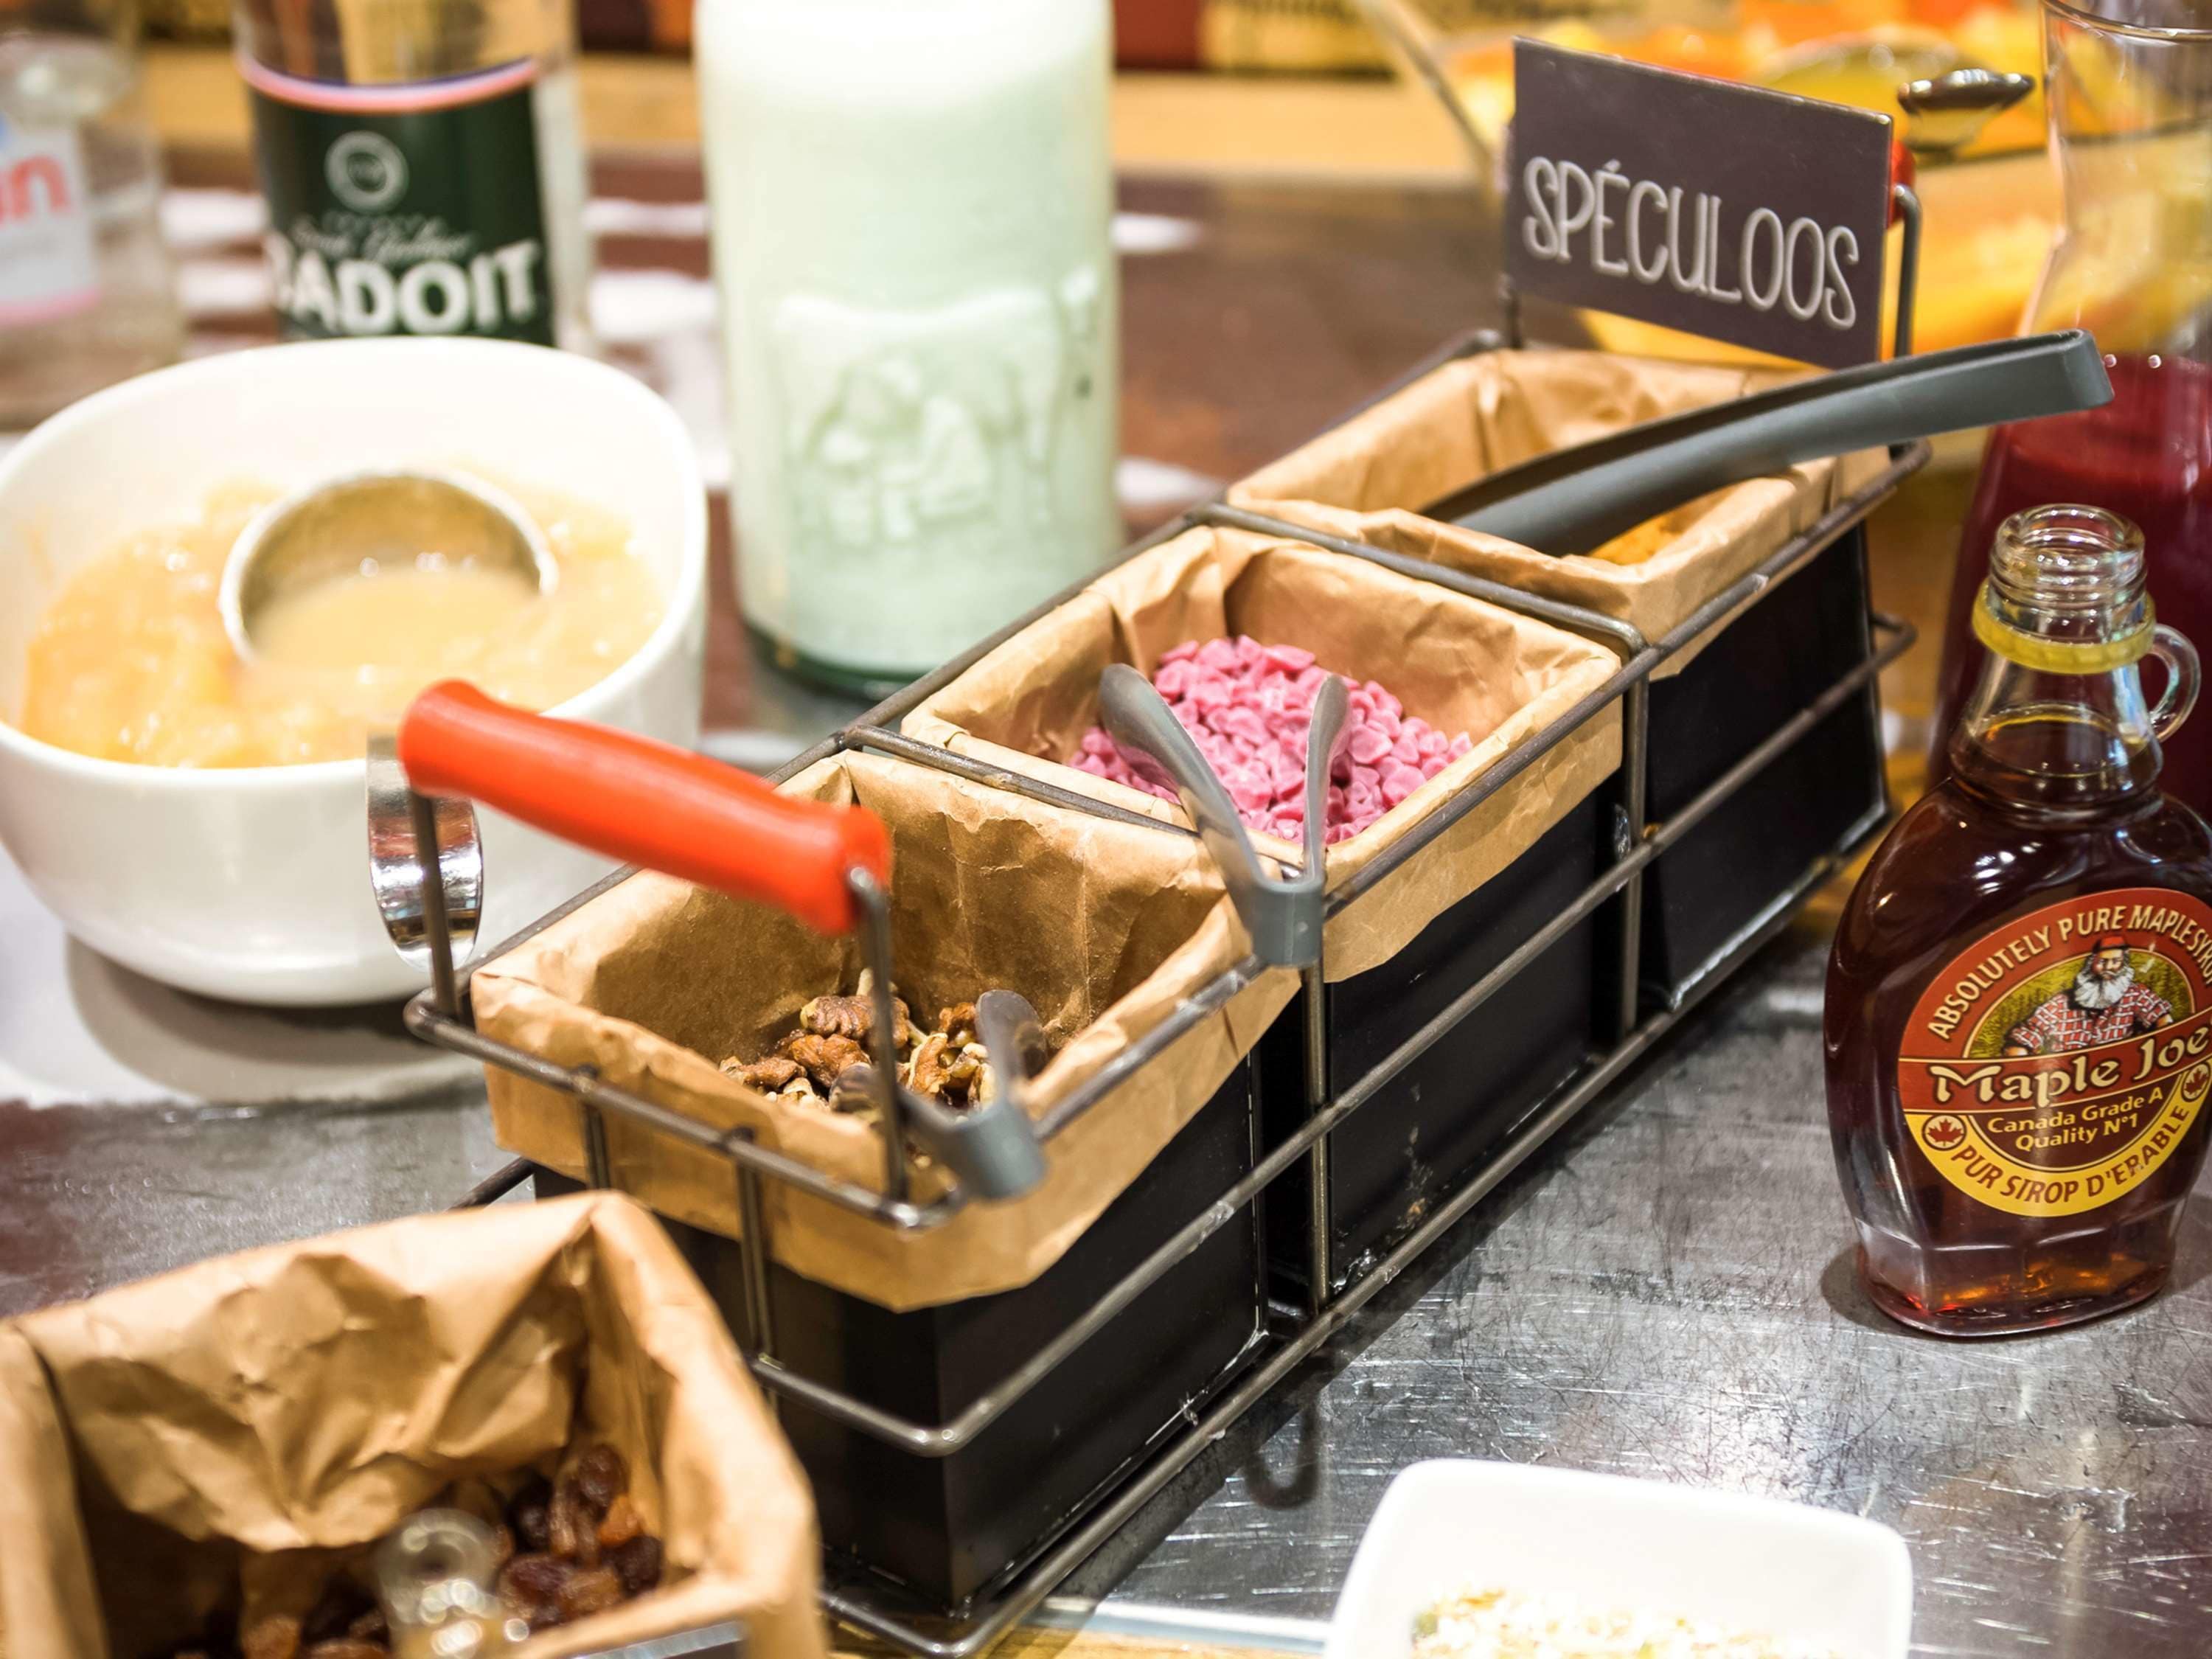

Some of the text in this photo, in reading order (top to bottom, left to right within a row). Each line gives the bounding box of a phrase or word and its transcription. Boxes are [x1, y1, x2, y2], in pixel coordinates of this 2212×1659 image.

[1522, 156, 1860, 330] SPÉCULOOS
[1927, 926, 2051, 1040] ABSOLUTELY
[2057, 905, 2126, 942] PURE
[2127, 904, 2197, 945] MAPLE
[1929, 1026, 2211, 1107] Maple Joe
[1987, 1087, 2164, 1134] Canada Grade A
[1950, 1105, 2190, 1205] PUR SIROP D'ERABLE
[2015, 1127, 2098, 1152] Quality
